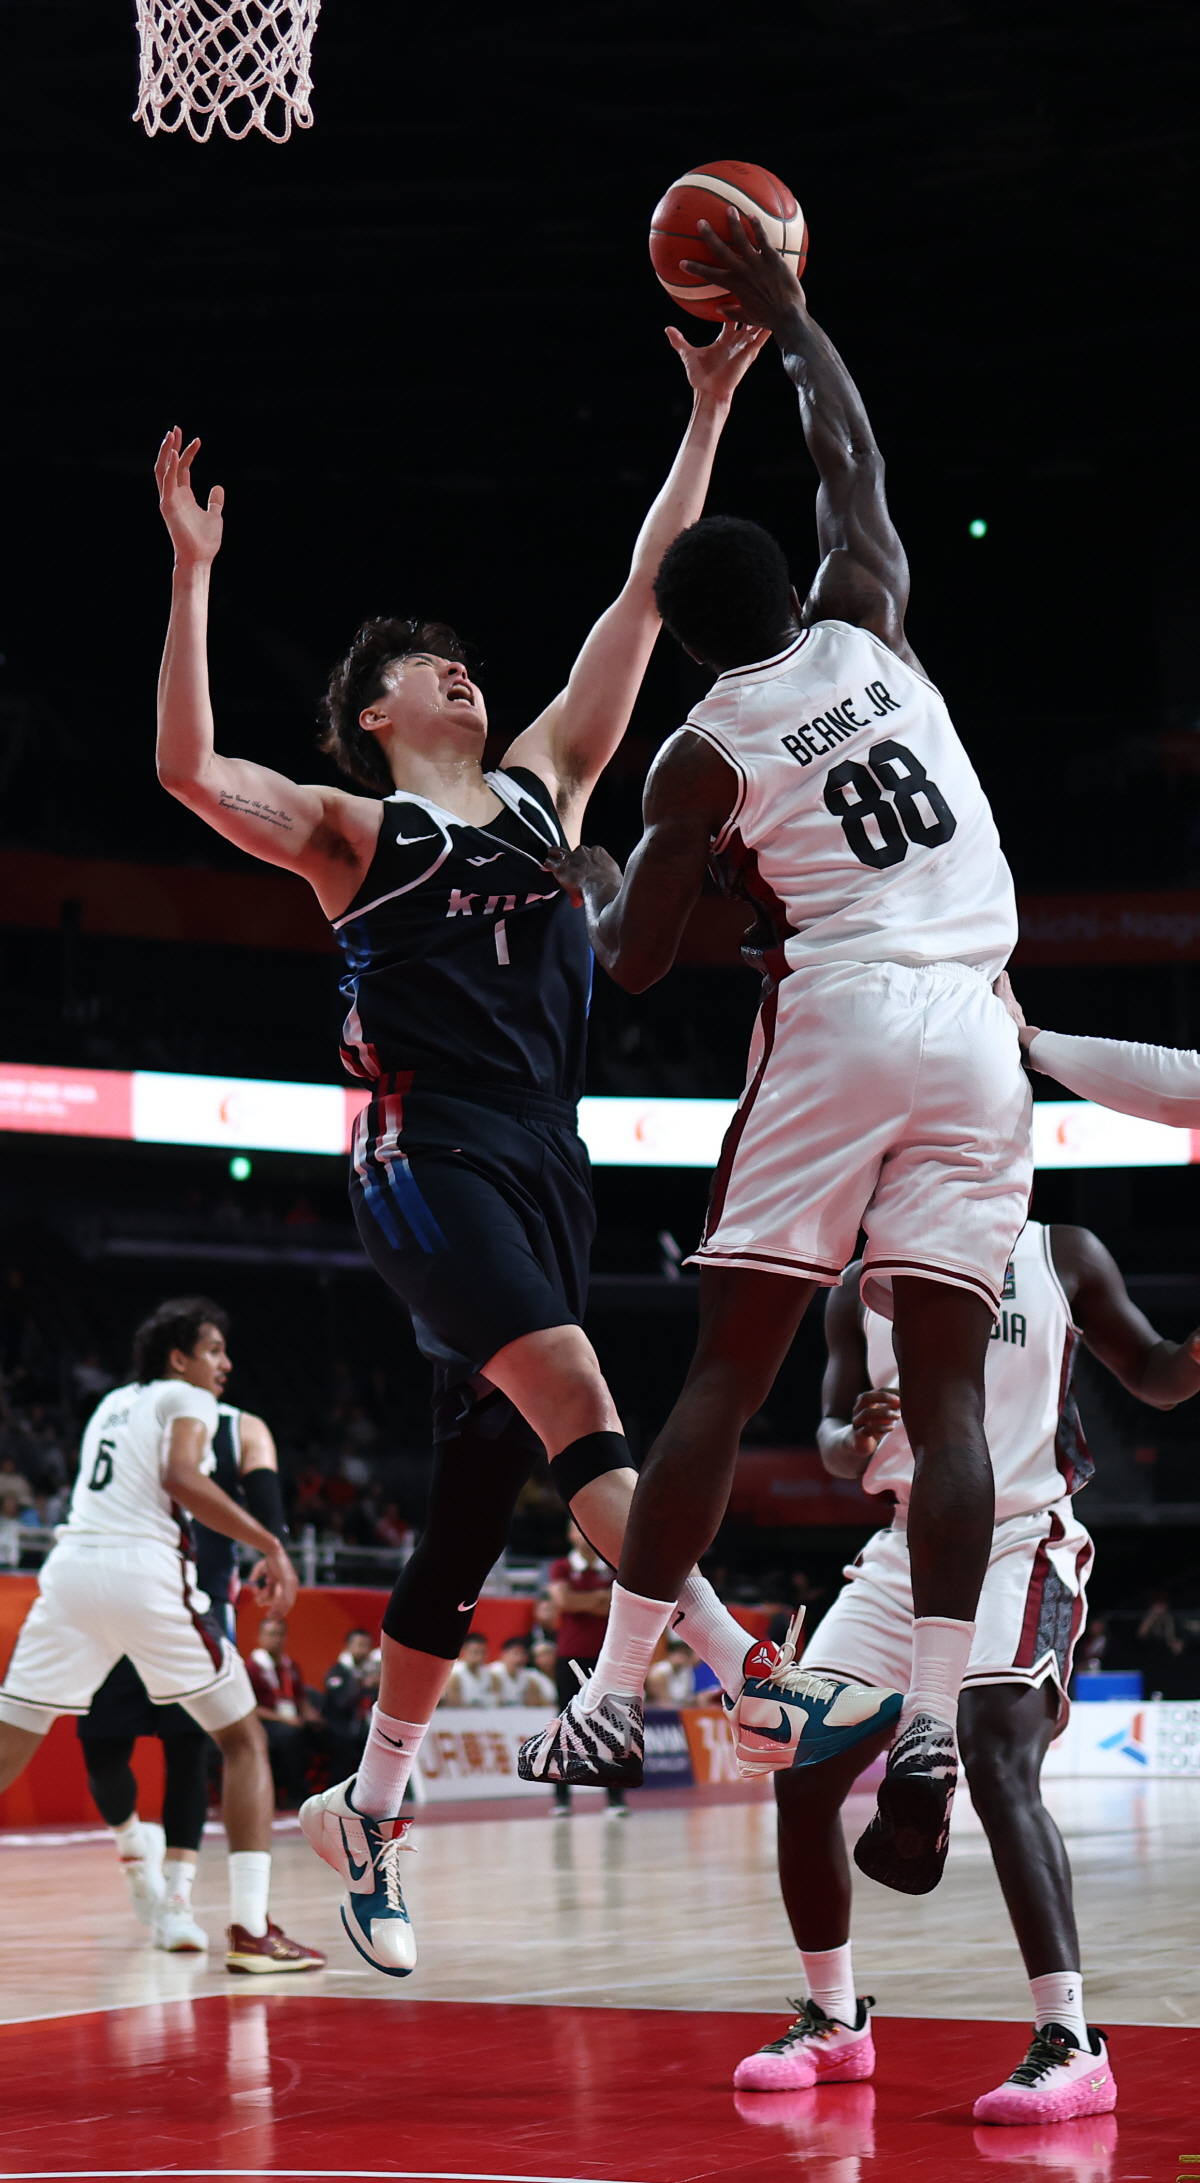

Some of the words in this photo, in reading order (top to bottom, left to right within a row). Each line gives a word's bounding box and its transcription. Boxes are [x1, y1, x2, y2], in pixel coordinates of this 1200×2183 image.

[781, 698, 871, 766] BEANE
[866, 681, 900, 717] JR
[824, 739, 956, 869] 88
[494, 918, 510, 966] 1
[88, 1439, 116, 1491] 6
